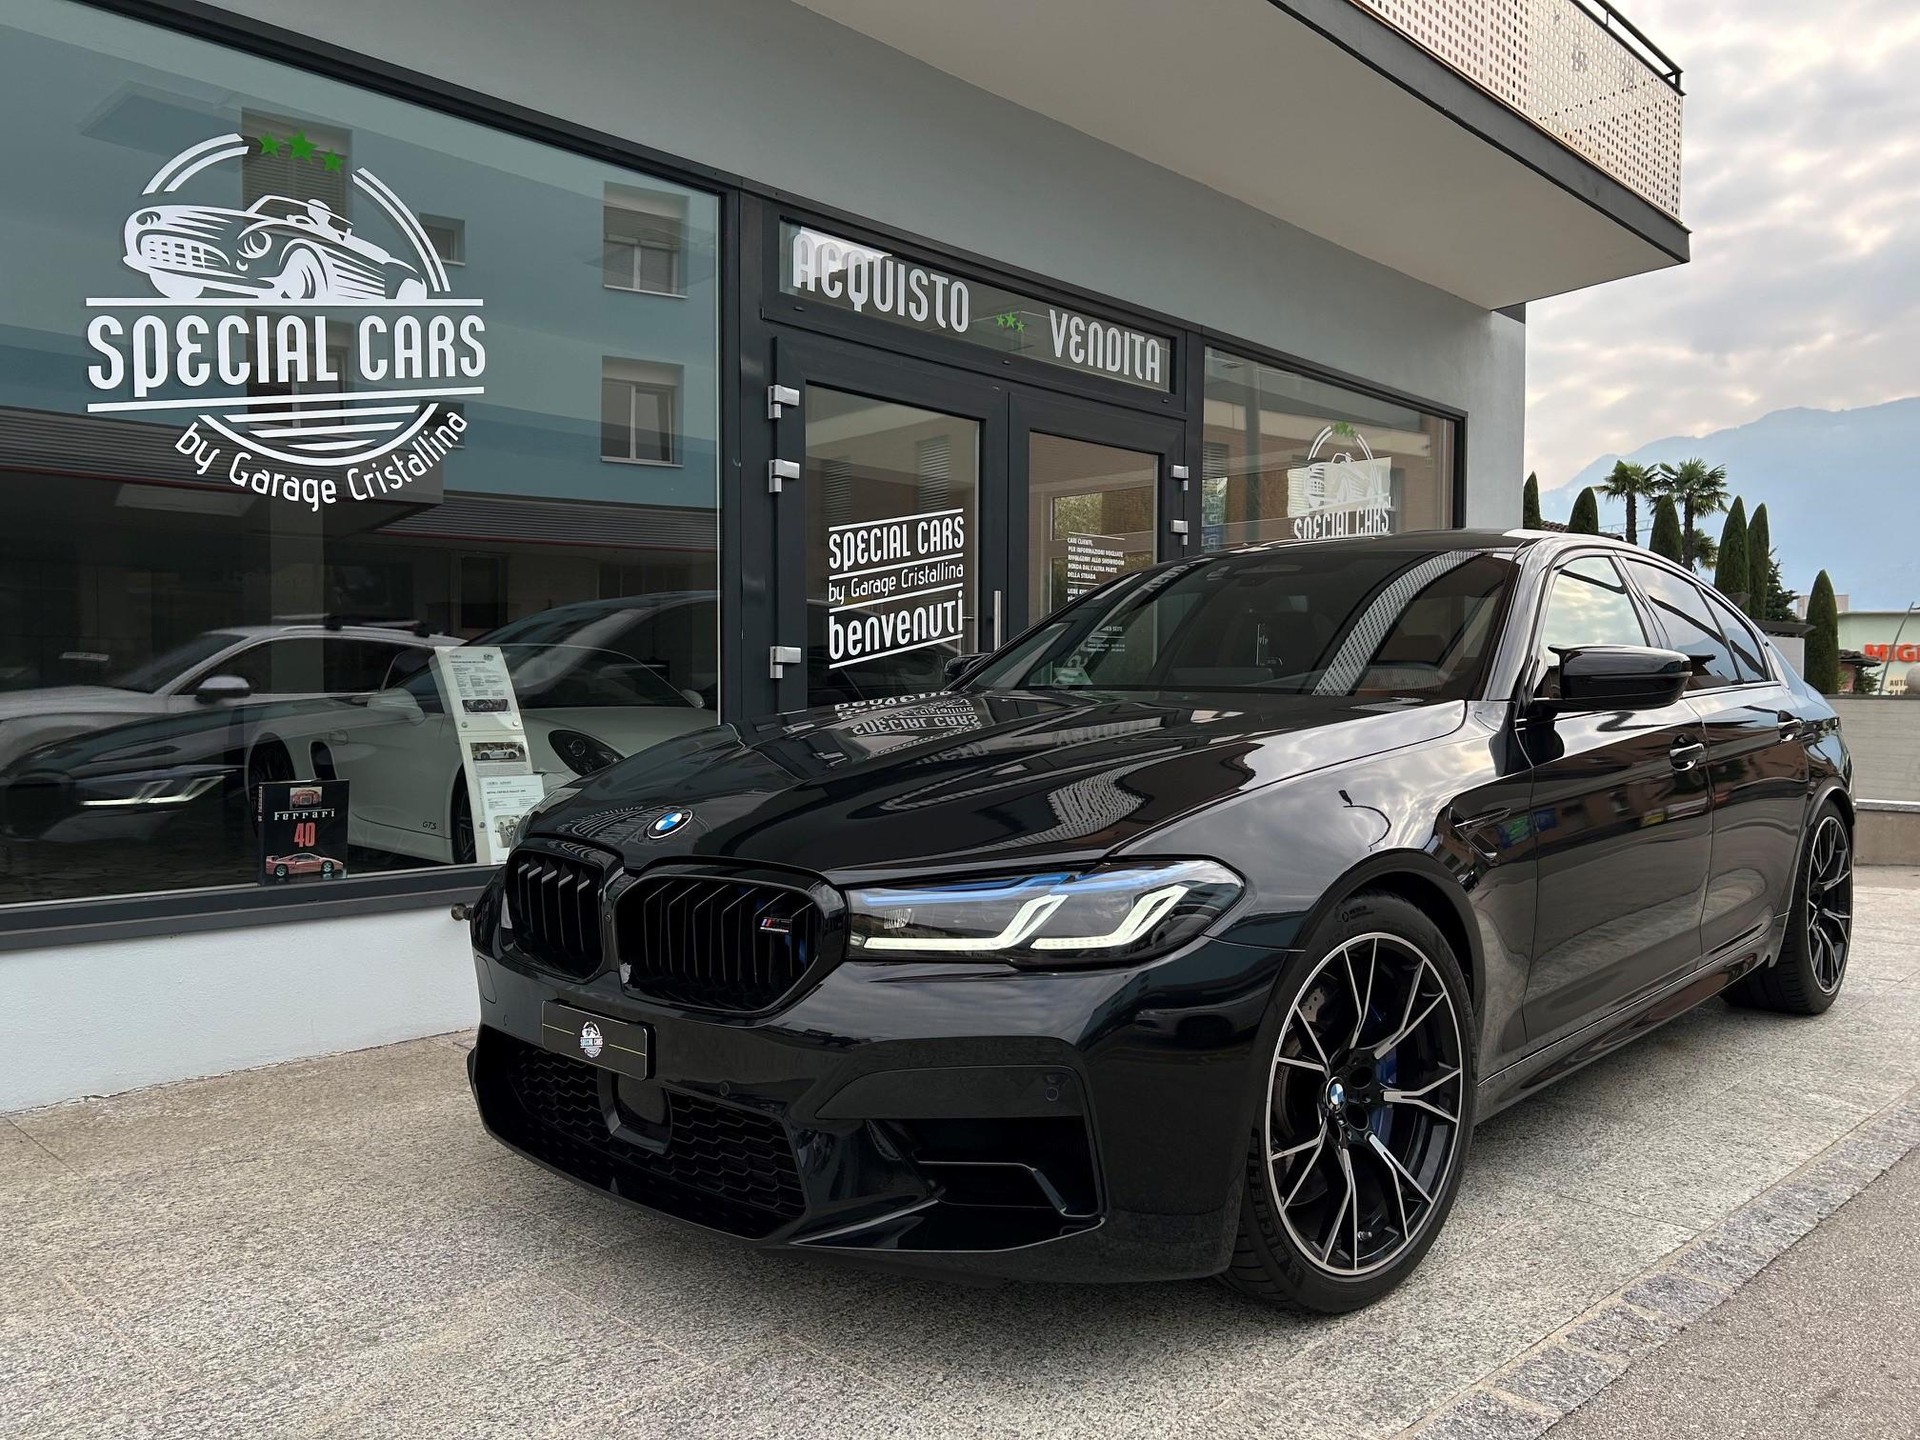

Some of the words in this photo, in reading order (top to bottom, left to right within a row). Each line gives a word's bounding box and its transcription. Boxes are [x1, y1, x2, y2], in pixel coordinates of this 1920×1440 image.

[793, 233, 969, 333] ACQUISTO
[1049, 308, 1160, 384] VENDITA
[87, 314, 338, 397] SPECIAL
[359, 314, 486, 381] CARS
[174, 422, 221, 475] by
[229, 453, 337, 512] Garage
[347, 411, 467, 501] Cristallina
[1356, 501, 1389, 534] CARS
[829, 524, 911, 571] SPECIAL
[918, 515, 964, 555] CARS
[829, 582, 845, 604] by
[851, 576, 897, 597] Garage
[901, 562, 964, 588] Cristallina
[829, 590, 963, 660] benvenuti
[1864, 643, 1920, 662] MIG
[274, 808, 335, 821] Ferrari
[294, 822, 316, 848] 40
[422, 821, 437, 829] GTS
